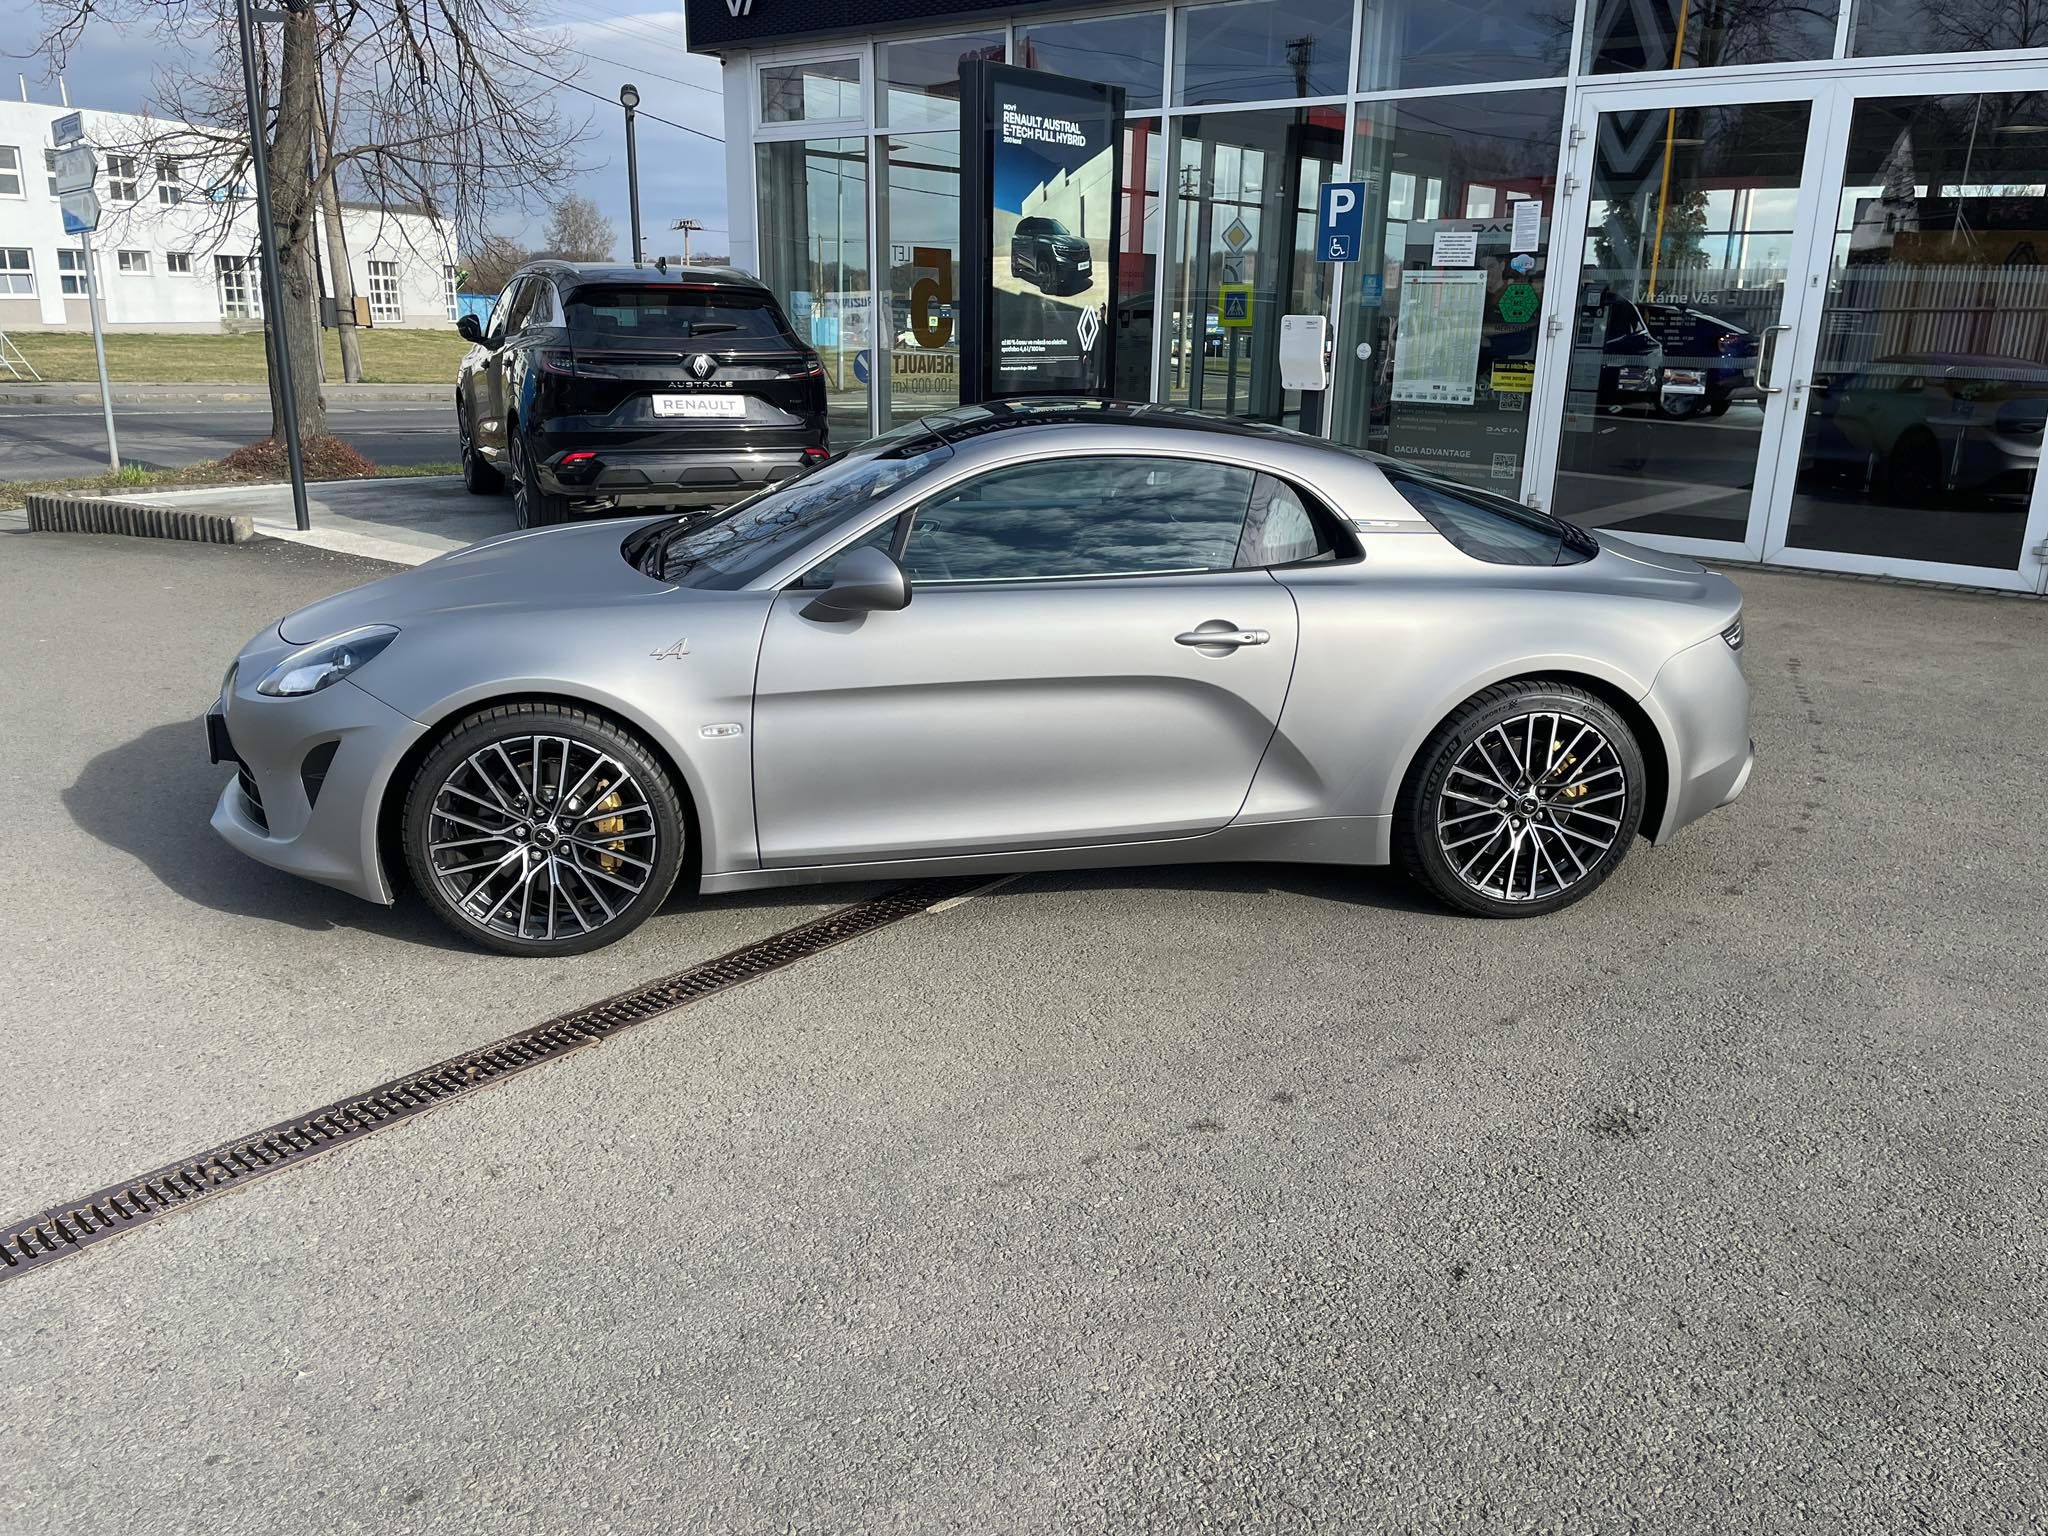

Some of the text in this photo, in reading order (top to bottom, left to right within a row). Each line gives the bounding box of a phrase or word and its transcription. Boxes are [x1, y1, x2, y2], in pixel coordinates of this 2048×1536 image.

[1003, 110, 1081, 135] RENAULT AUSTRAL
[1003, 123, 1086, 147] E-TECH FULL HYBRID
[1328, 188, 1356, 228] P
[1472, 223, 1513, 233] DAC
[1692, 290, 1718, 304] Vás
[663, 399, 736, 410] RENAULT
[1394, 445, 1471, 458] DACIA ADVANTAGE
